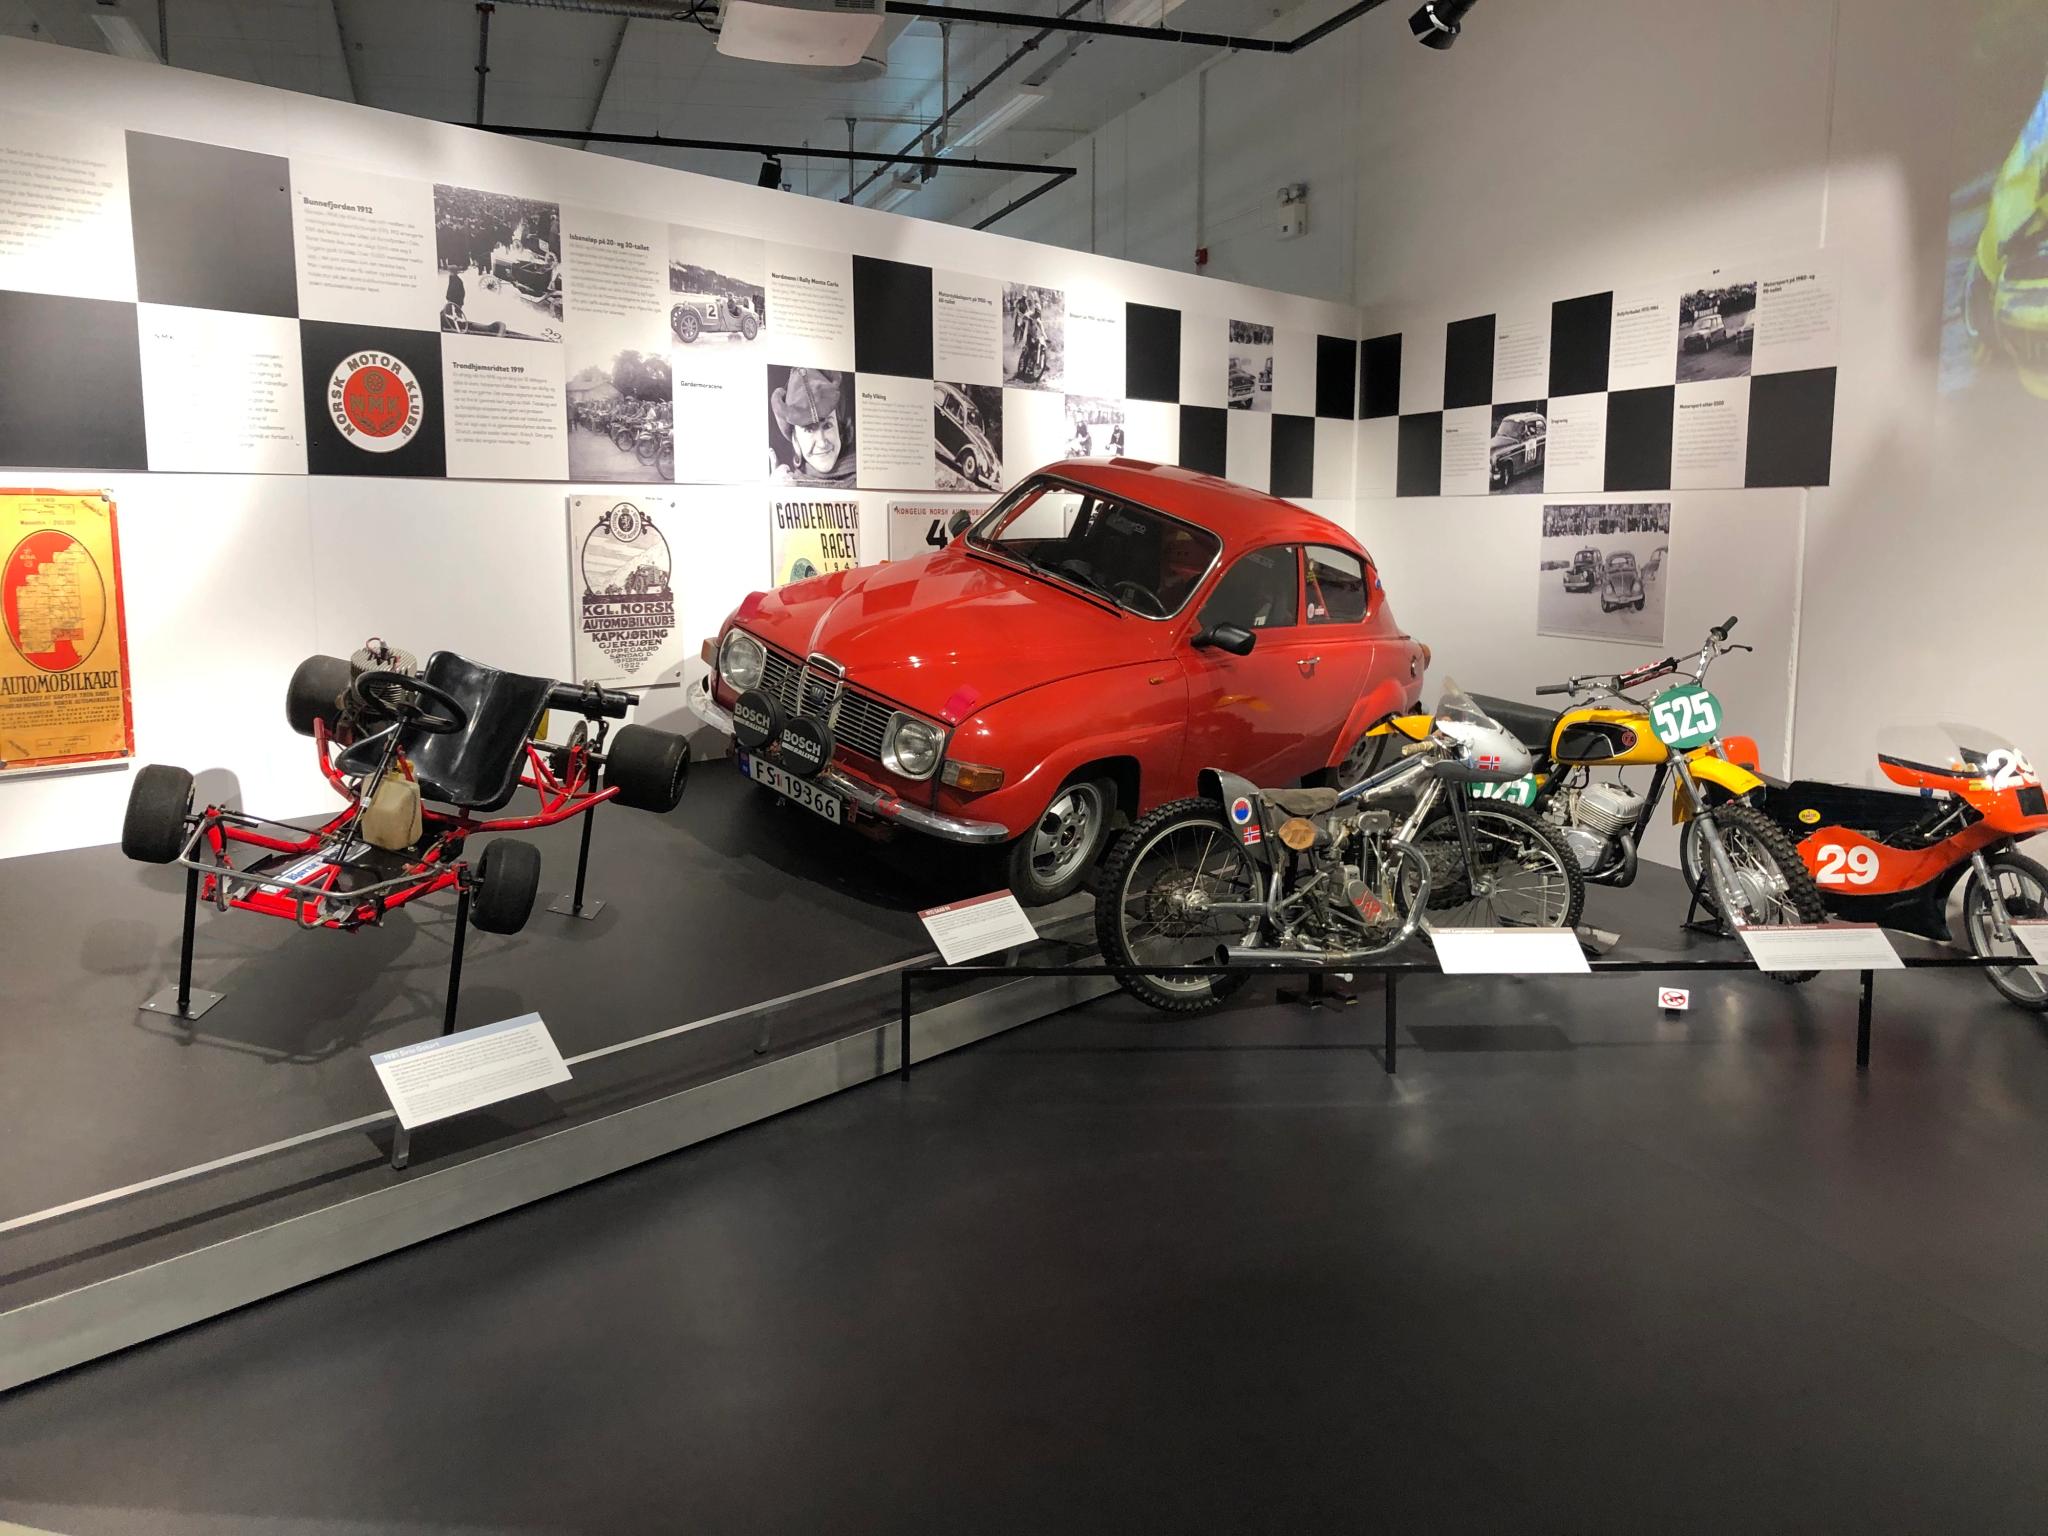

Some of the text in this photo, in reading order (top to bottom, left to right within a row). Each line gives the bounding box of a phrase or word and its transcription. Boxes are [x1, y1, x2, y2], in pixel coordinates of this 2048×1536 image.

[303, 197, 373, 214] Bunnefjorden 1912
[708, 305, 717, 317] 2
[332, 376, 355, 437] NORSK
[347, 354, 402, 375] MOTOR
[401, 380, 420, 436] KLUBB
[896, 507, 927, 516] KONGELIG
[929, 508, 949, 516] NORSK
[820, 532, 857, 559] RACET
[582, 602, 675, 616] KGL. NORSK
[592, 629, 669, 642] KAPKJØRING
[598, 639, 663, 649] GJERSJØEN
[0, 670, 119, 696] AUTOMOBILKART
[735, 702, 771, 729] BOSCH
[1652, 690, 1717, 744] 525
[783, 728, 821, 757] BOSCH
[755, 761, 835, 819] FS 19366
[1815, 843, 1880, 885] 29
